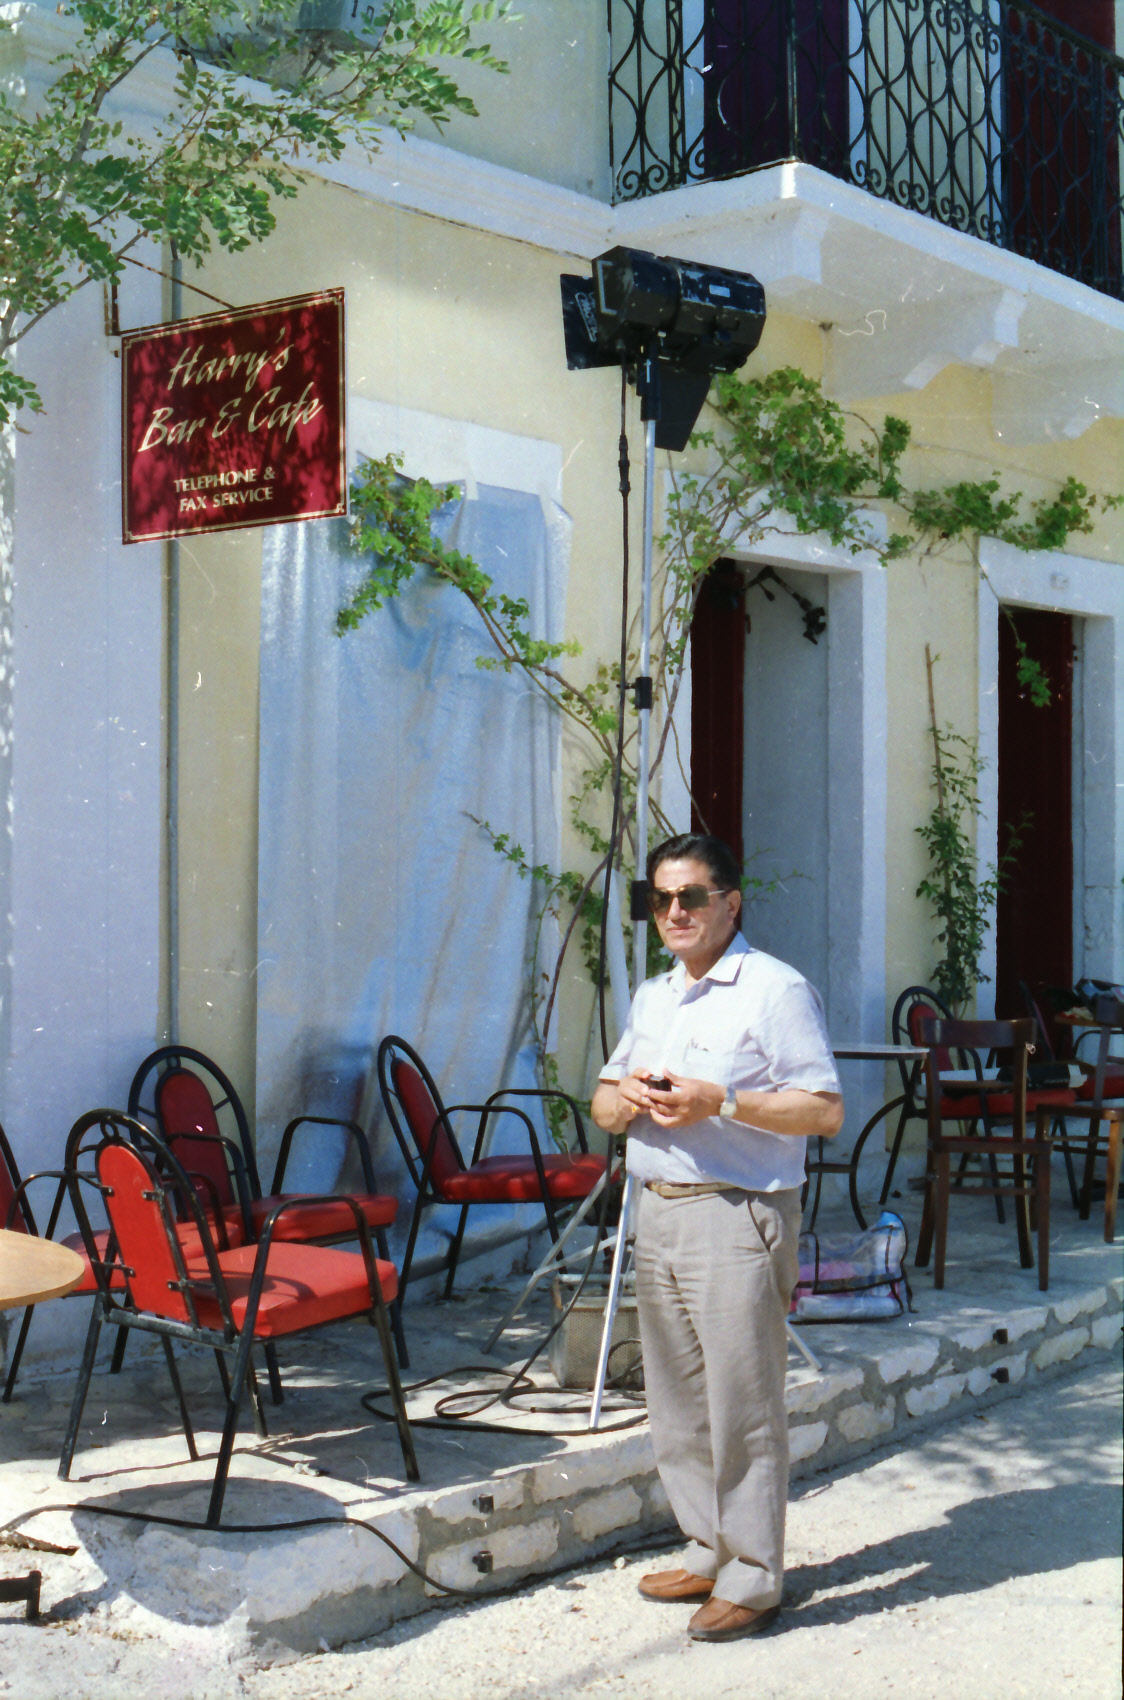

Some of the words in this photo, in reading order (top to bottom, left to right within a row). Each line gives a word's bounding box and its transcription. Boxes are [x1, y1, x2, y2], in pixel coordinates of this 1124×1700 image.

[167, 326, 295, 391] Harry's
[137, 406, 207, 453] Bar
[247, 381, 325, 444] Cafe
[173, 468, 257, 493] TELEPHONE
[263, 466, 276, 481] &
[180, 495, 207, 512] FAX
[212, 486, 274, 508] SERVICE
